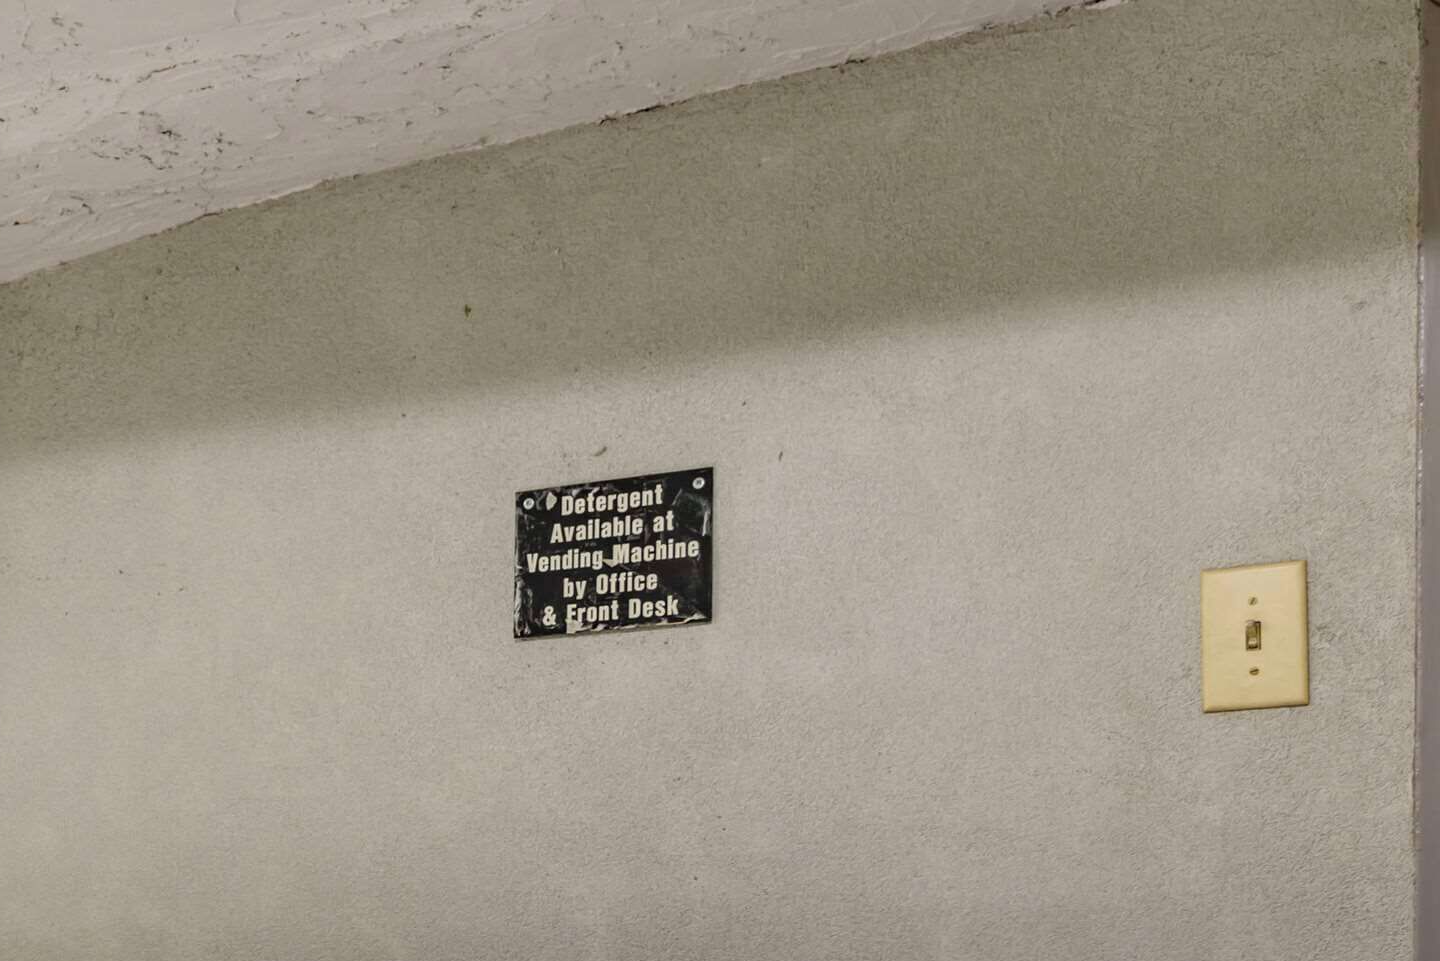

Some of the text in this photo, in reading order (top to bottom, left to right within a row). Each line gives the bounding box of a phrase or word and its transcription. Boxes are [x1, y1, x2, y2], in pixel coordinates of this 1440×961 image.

[561, 484, 664, 516] Detergent
[550, 510, 674, 544] Available at
[526, 539, 700, 574] Vending Machine
[563, 573, 658, 599] by Office
[542, 595, 679, 626] & Front Desk
